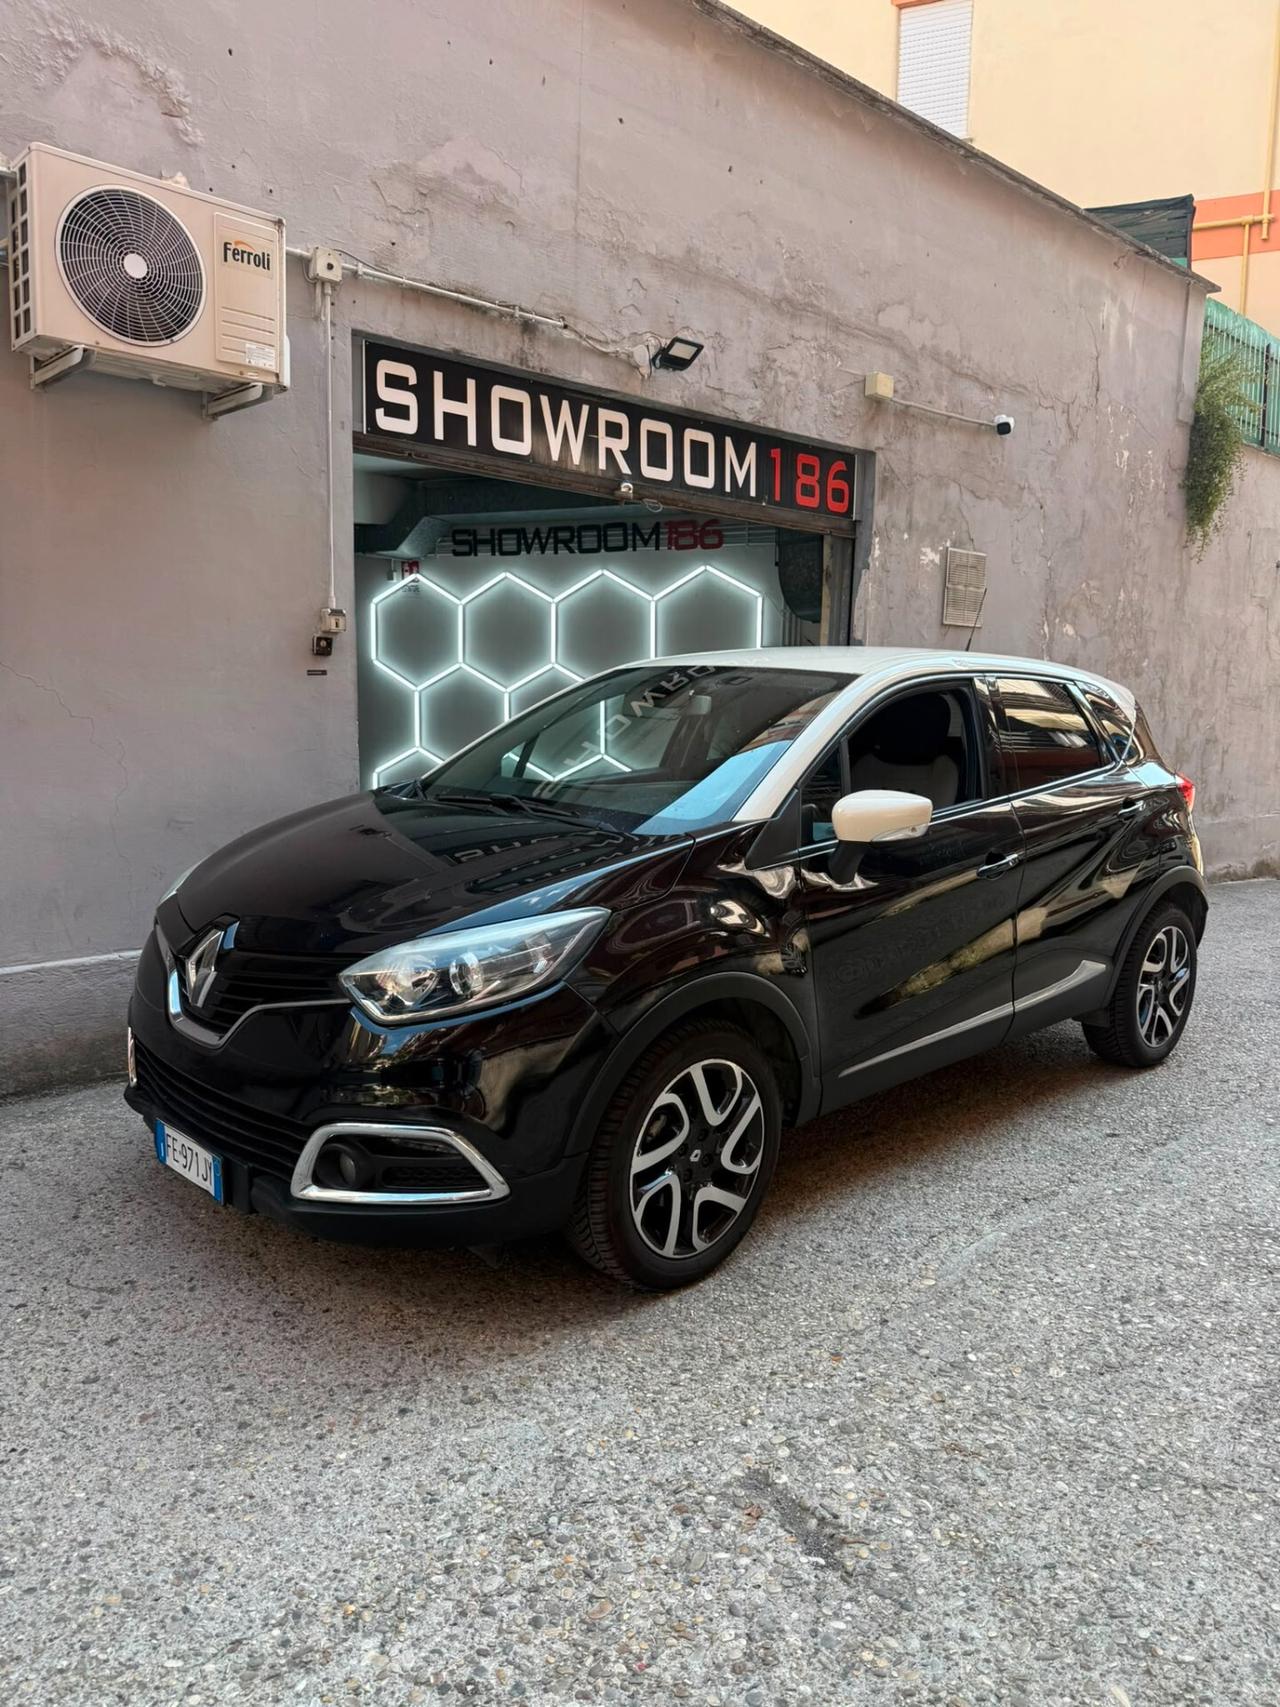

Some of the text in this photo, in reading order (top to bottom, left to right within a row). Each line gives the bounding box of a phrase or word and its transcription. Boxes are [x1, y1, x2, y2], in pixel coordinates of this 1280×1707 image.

[223, 241, 271, 271] Ferroli
[375, 358, 849, 513] SHOWROOM 186
[452, 519, 724, 556] SHOWROOM 186
